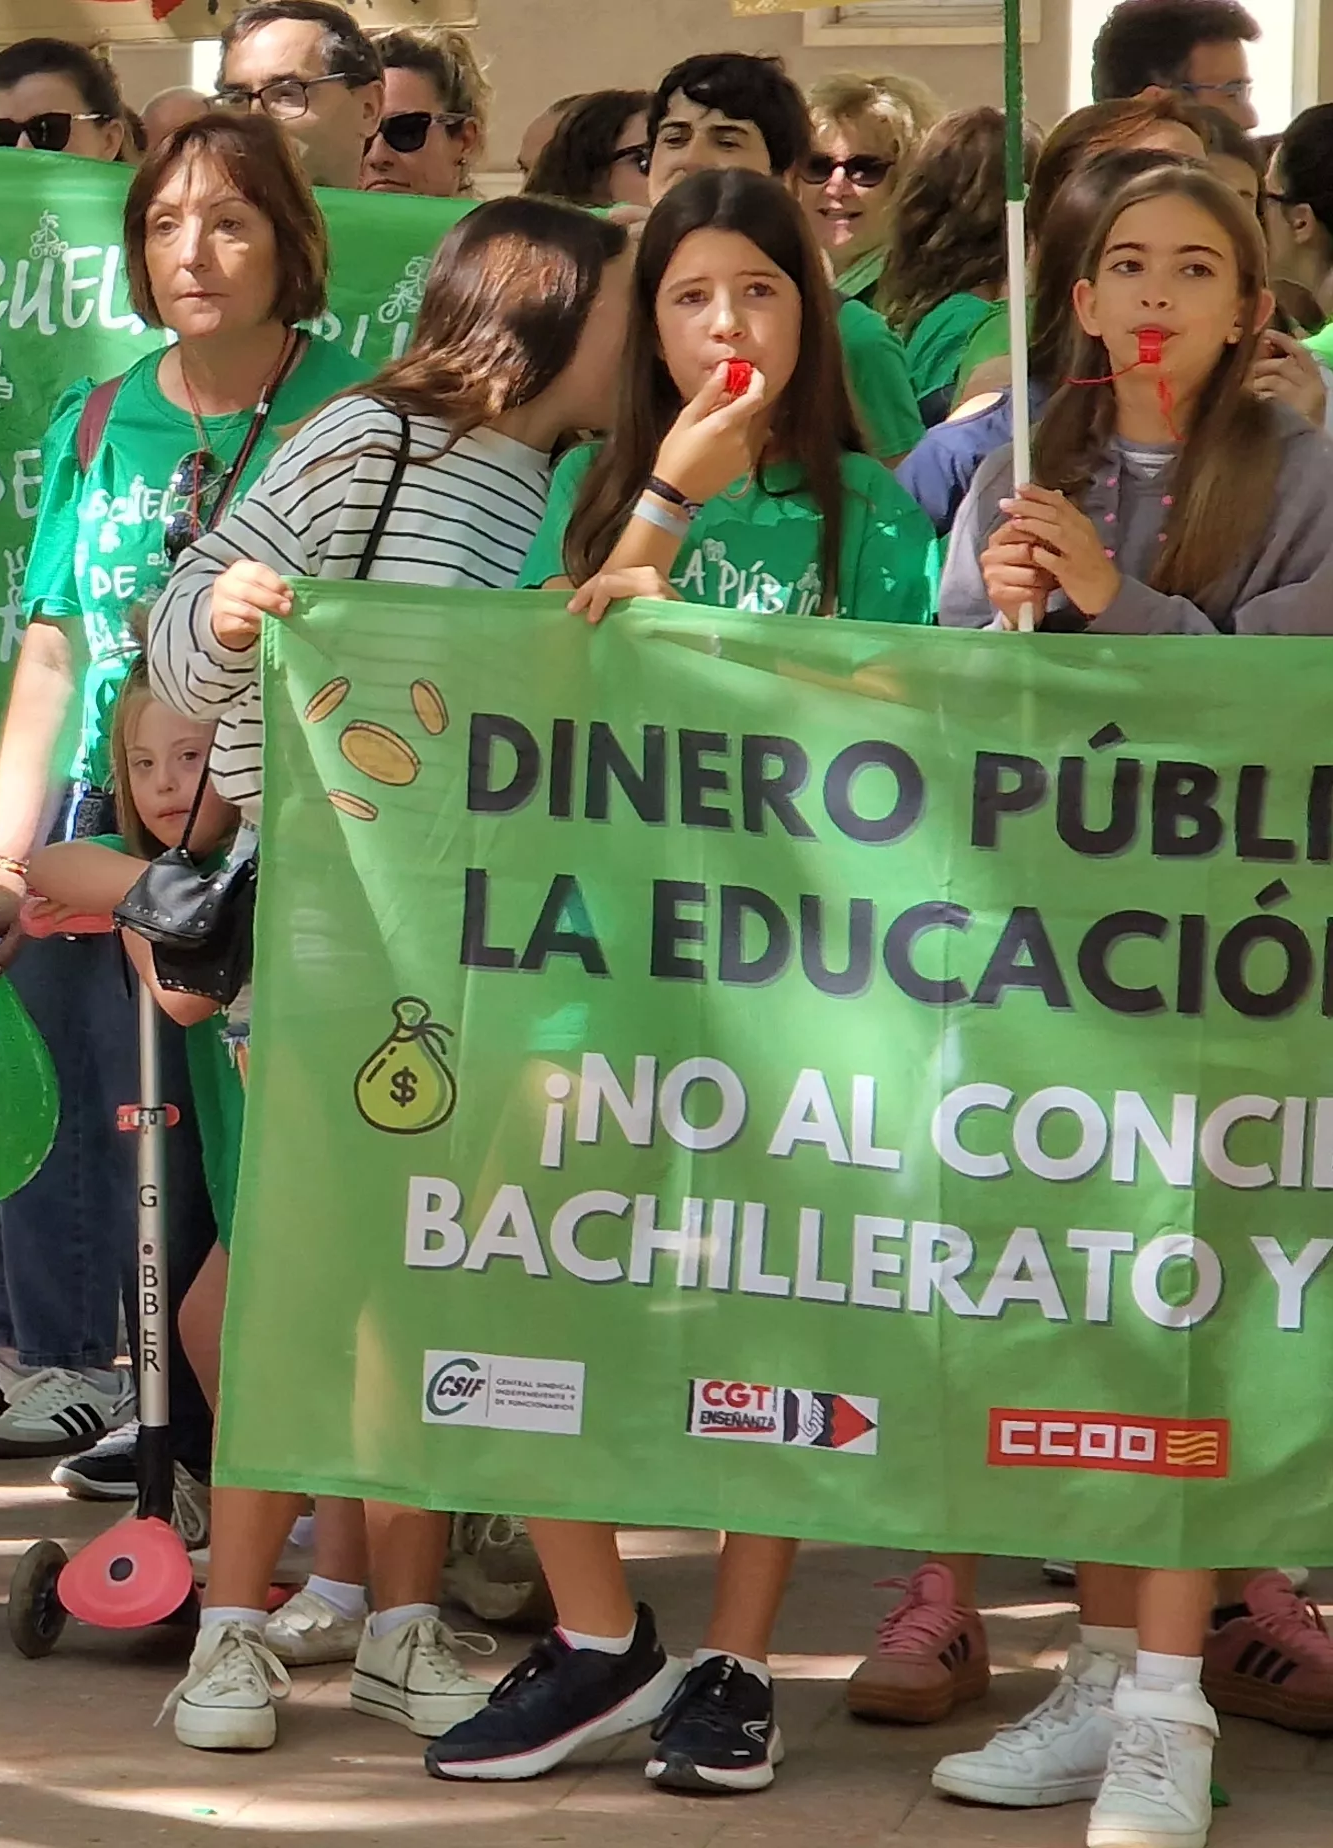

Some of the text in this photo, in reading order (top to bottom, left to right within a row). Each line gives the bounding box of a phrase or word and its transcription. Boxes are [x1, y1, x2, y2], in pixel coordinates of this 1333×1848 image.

[90, 564, 138, 600] DE
[465, 711, 928, 846] DINERO
[458, 867, 1333, 1020] LA EDUCACIÓ
[539, 1051, 748, 1170] ¡NO
[766, 1069, 904, 1171] AL
[402, 1174, 1333, 1332] BACHILLERATO Y
[436, 1375, 486, 1398] CSIF
[702, 1380, 772, 1411] CGT
[699, 1410, 777, 1430] ENSEÑANZA
[1000, 1420, 1157, 1462] CCOO
